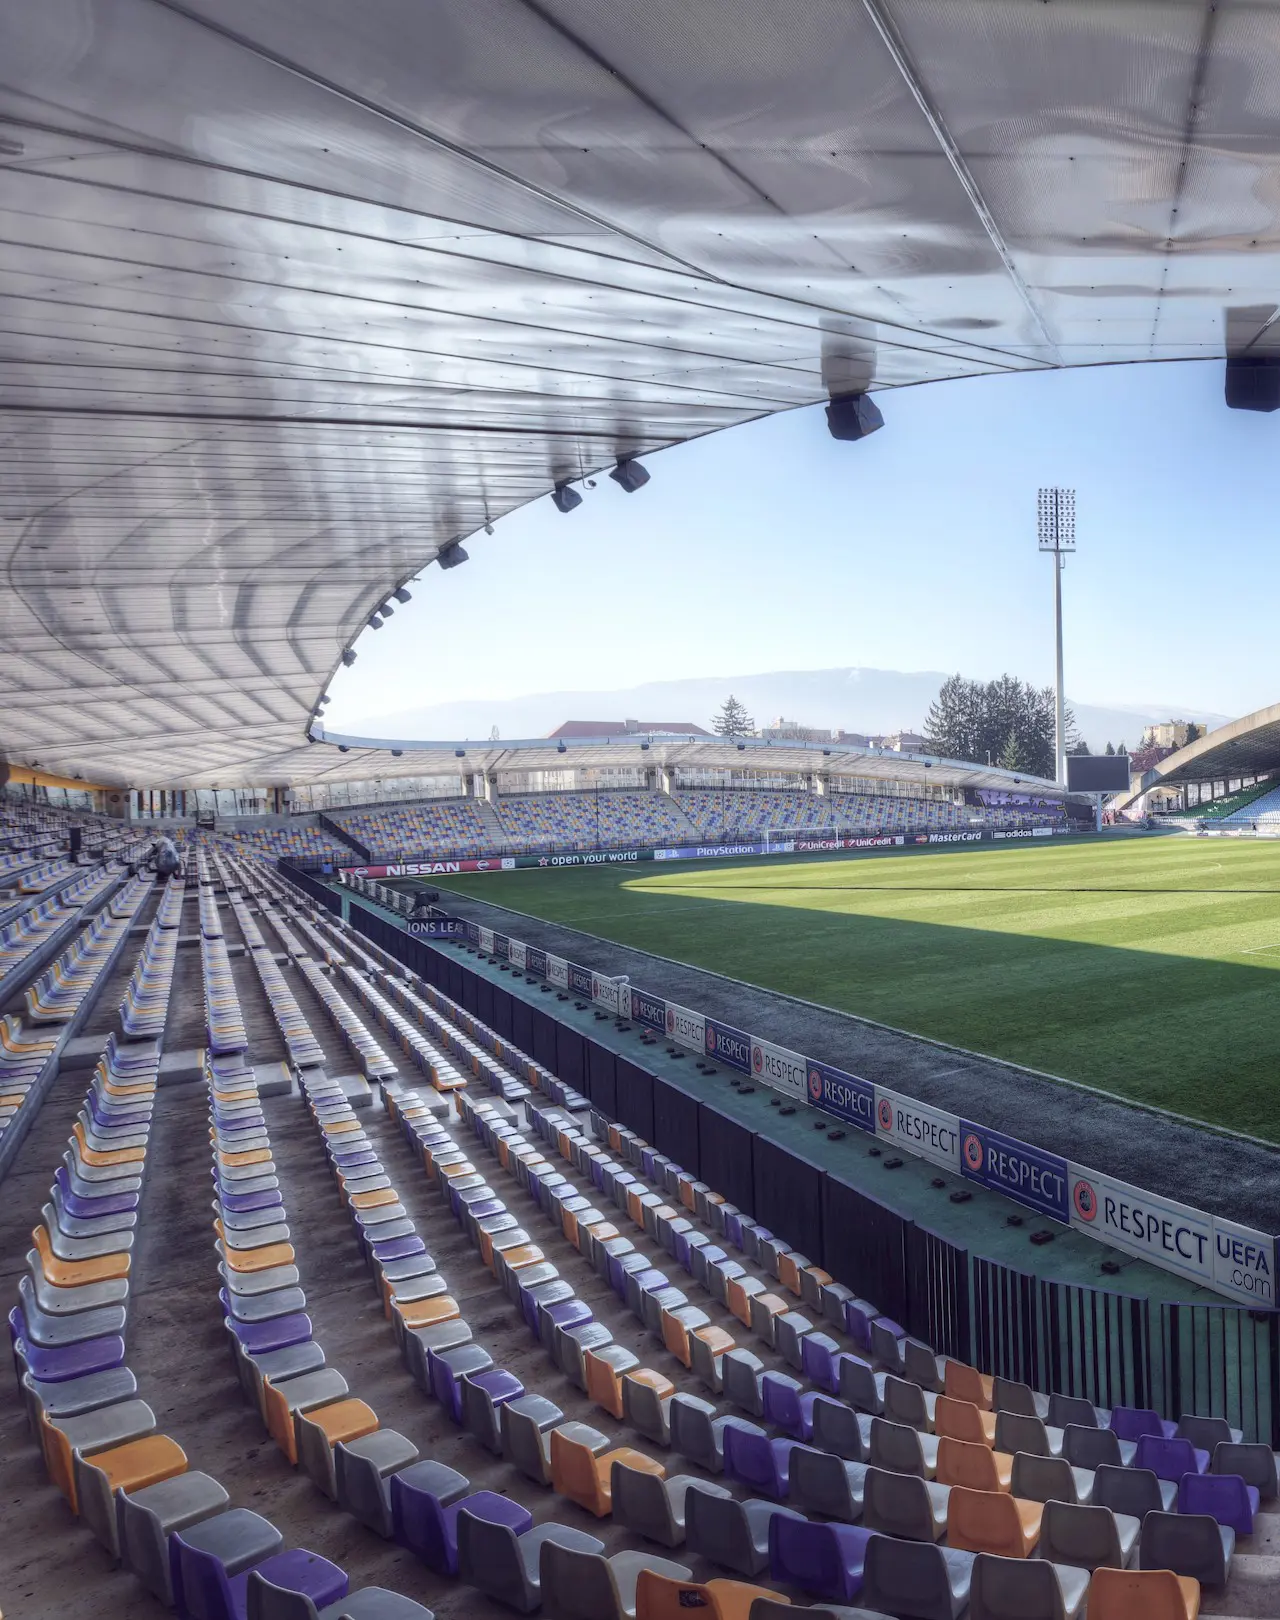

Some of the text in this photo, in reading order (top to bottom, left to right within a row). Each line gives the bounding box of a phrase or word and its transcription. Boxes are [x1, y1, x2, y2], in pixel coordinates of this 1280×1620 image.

[807, 840, 845, 850] UniCredit
[856, 837, 892, 847] UniCredit
[929, 832, 982, 843] MasterCard
[1005, 829, 1032, 838] adidas
[551, 851, 638, 866] open your world
[696, 845, 754, 856] PlayStation
[386, 862, 460, 877] NISSAN
[640, 1001, 665, 1024] RESPECT
[676, 1016, 704, 1042] RESPECT
[716, 1034, 750, 1063] RESPECT
[765, 1055, 805, 1088] RESPECT
[824, 1080, 873, 1118] RESPECT
[897, 1110, 957, 1154] RESPECT
[988, 1147, 1065, 1203] RESPECT
[1105, 1196, 1208, 1264] RESPECT
[1216, 1234, 1270, 1275] UEFA
[1230, 1269, 1271, 1298] .com
